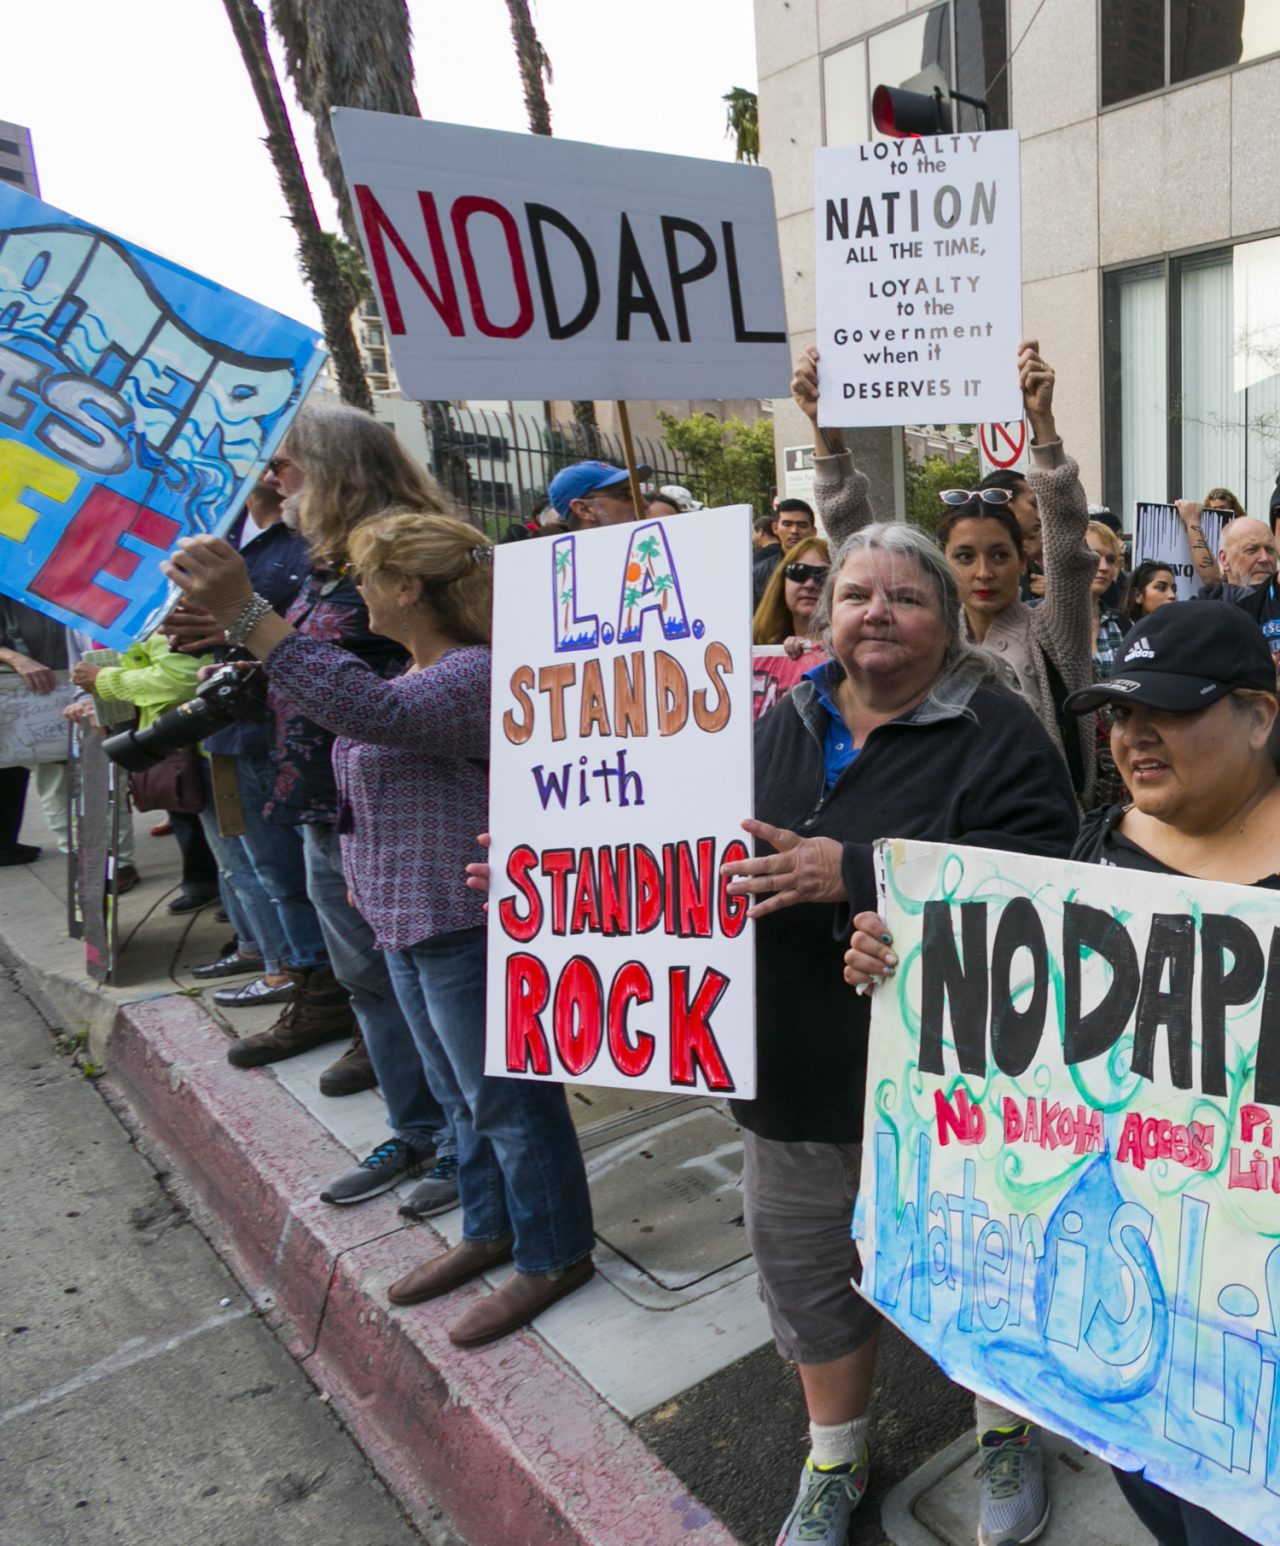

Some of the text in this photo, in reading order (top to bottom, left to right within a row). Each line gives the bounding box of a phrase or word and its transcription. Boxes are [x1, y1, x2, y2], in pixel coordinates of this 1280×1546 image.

[860, 135, 982, 161] LOYALTY
[890, 157, 947, 175] to the
[825, 180, 997, 241] NATION
[845, 237, 986, 264] ALL THE TIME,
[869, 276, 981, 299] LOYALTY
[897, 299, 955, 316] to the
[833, 322, 993, 345] Government
[863, 344, 941, 365] when it
[843, 379, 982, 400] DESERVES IT
[551, 521, 706, 653] L.A.
[502, 641, 734, 745] STANDS
[500, 836, 750, 943] STANDING
[505, 951, 736, 1093] ROCK
[875, 1130, 1047, 1334] Water
